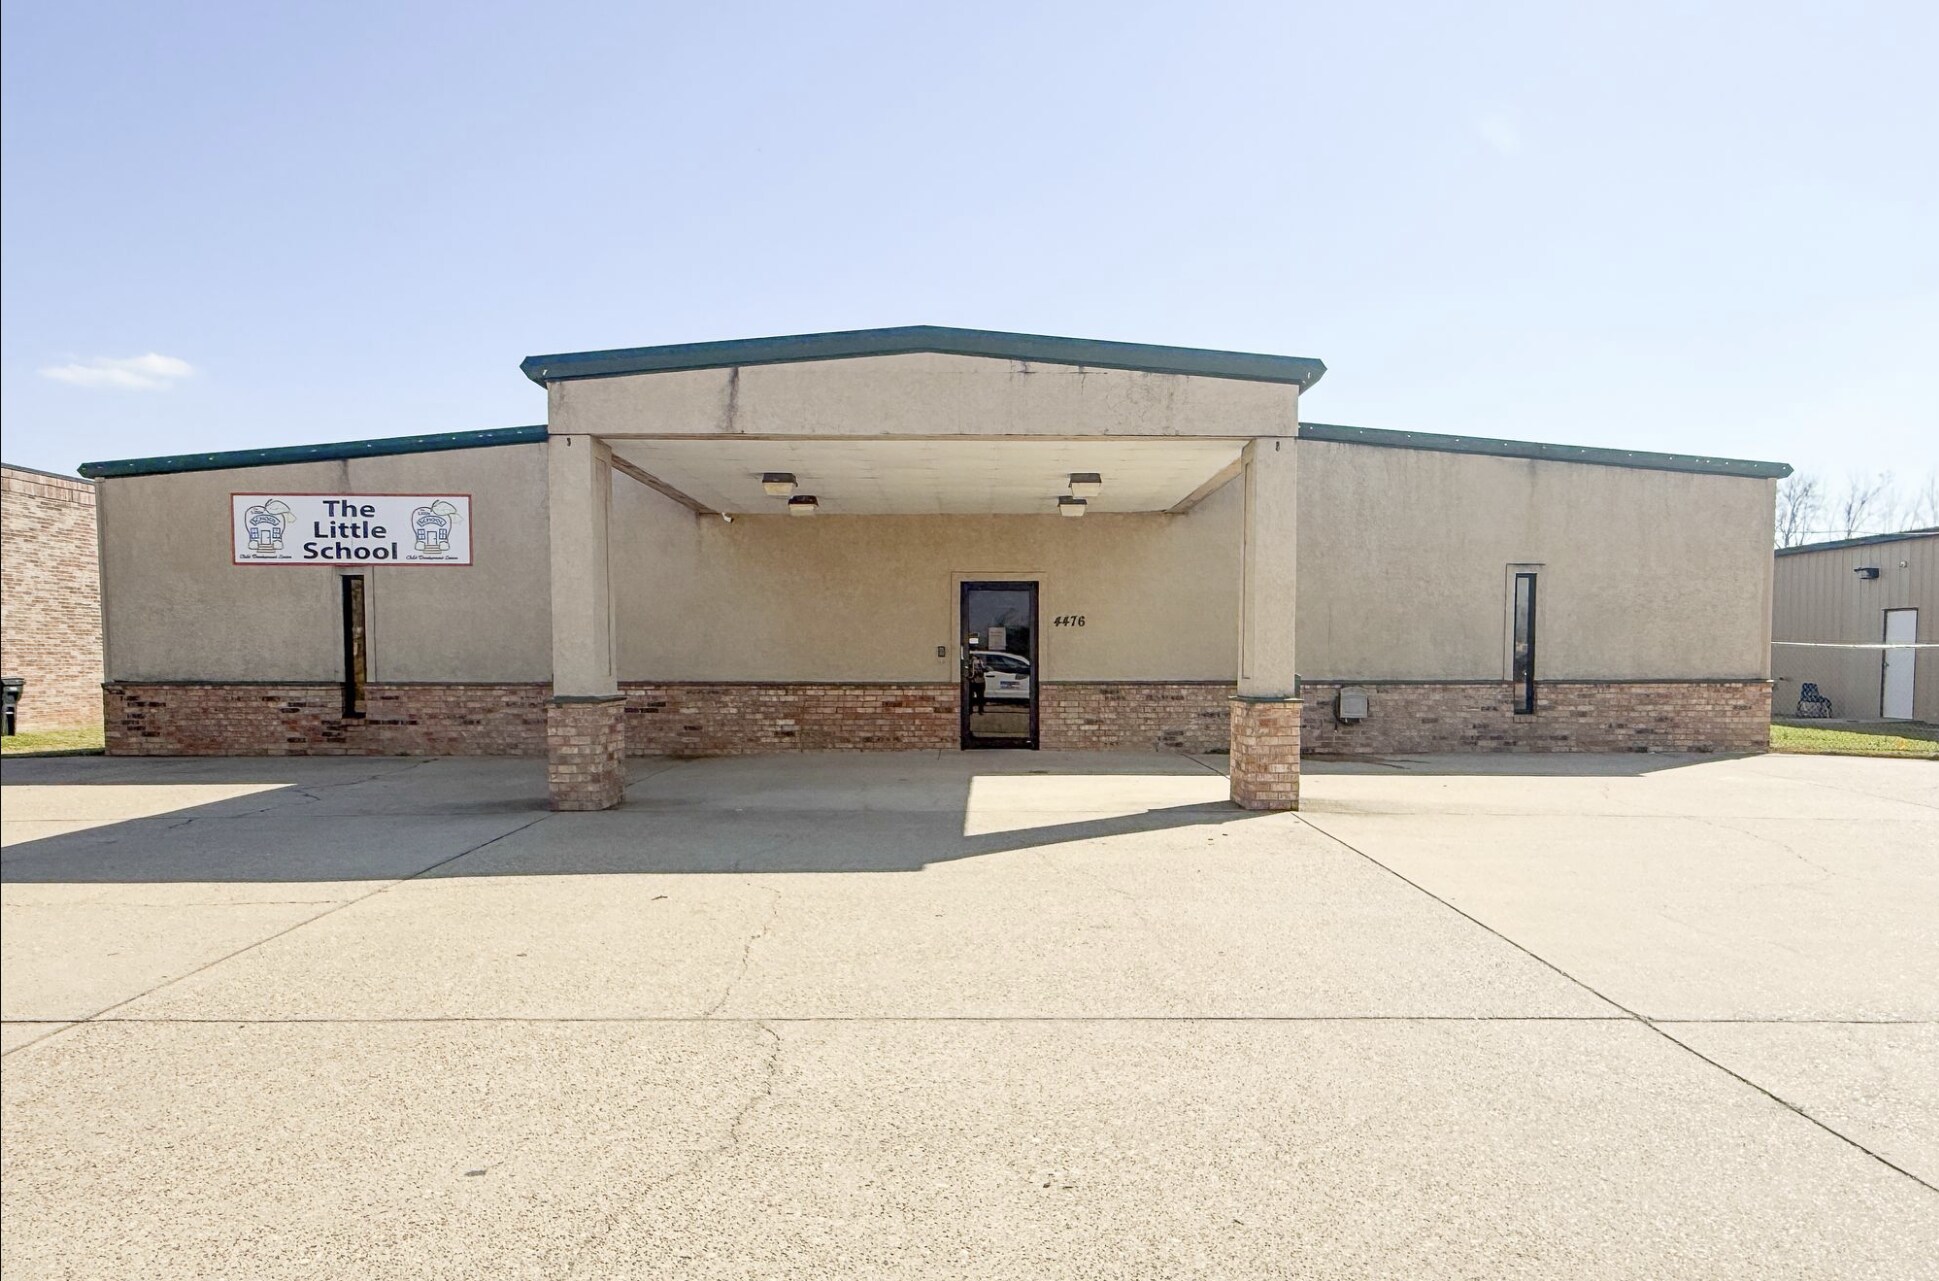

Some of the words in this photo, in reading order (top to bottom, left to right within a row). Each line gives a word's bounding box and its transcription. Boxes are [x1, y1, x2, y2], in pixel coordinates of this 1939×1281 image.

[322, 499, 376, 518] The
[313, 520, 387, 539] Little
[303, 541, 398, 560] School
[1053, 615, 1086, 628] 4476
